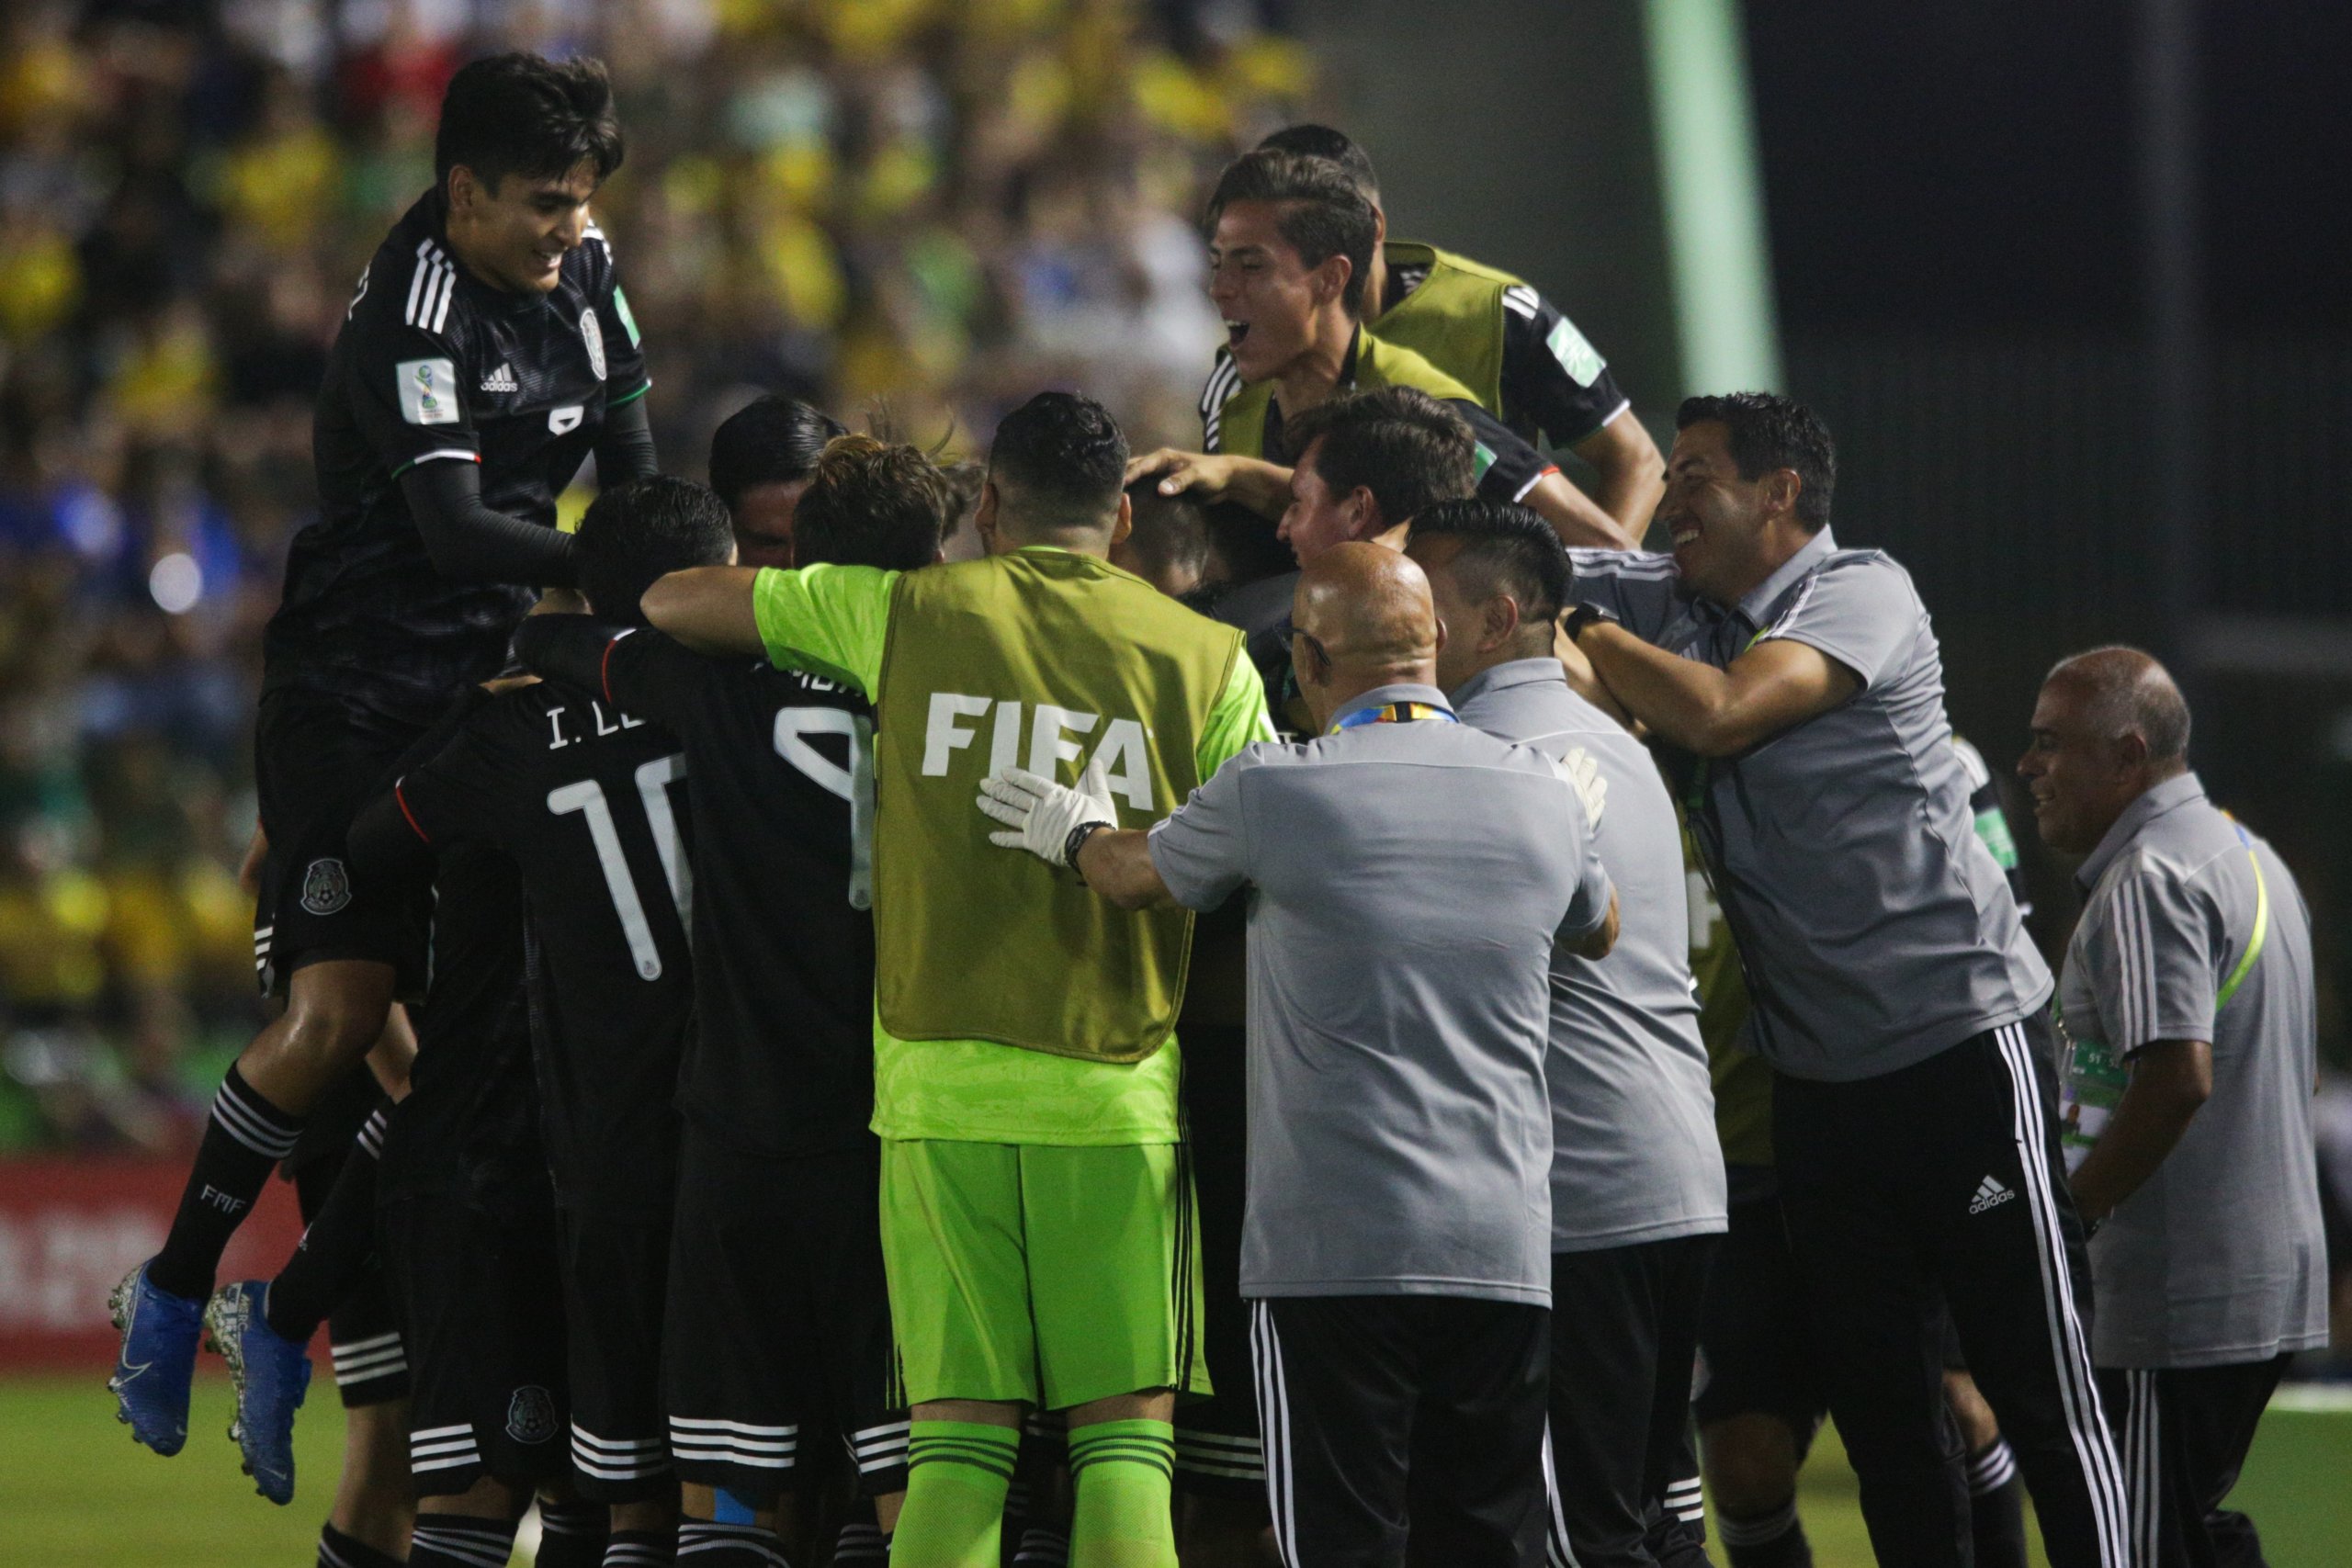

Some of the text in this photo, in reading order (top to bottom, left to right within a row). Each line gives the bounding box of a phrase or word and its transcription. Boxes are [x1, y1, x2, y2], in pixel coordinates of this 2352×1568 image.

[481, 380, 517, 392] adidas
[547, 706, 582, 750] I.
[922, 693, 1154, 812] FIFA
[774, 706, 874, 911] 9
[200, 1184, 245, 1213] FMF
[1969, 1190, 2016, 1214] adidas
